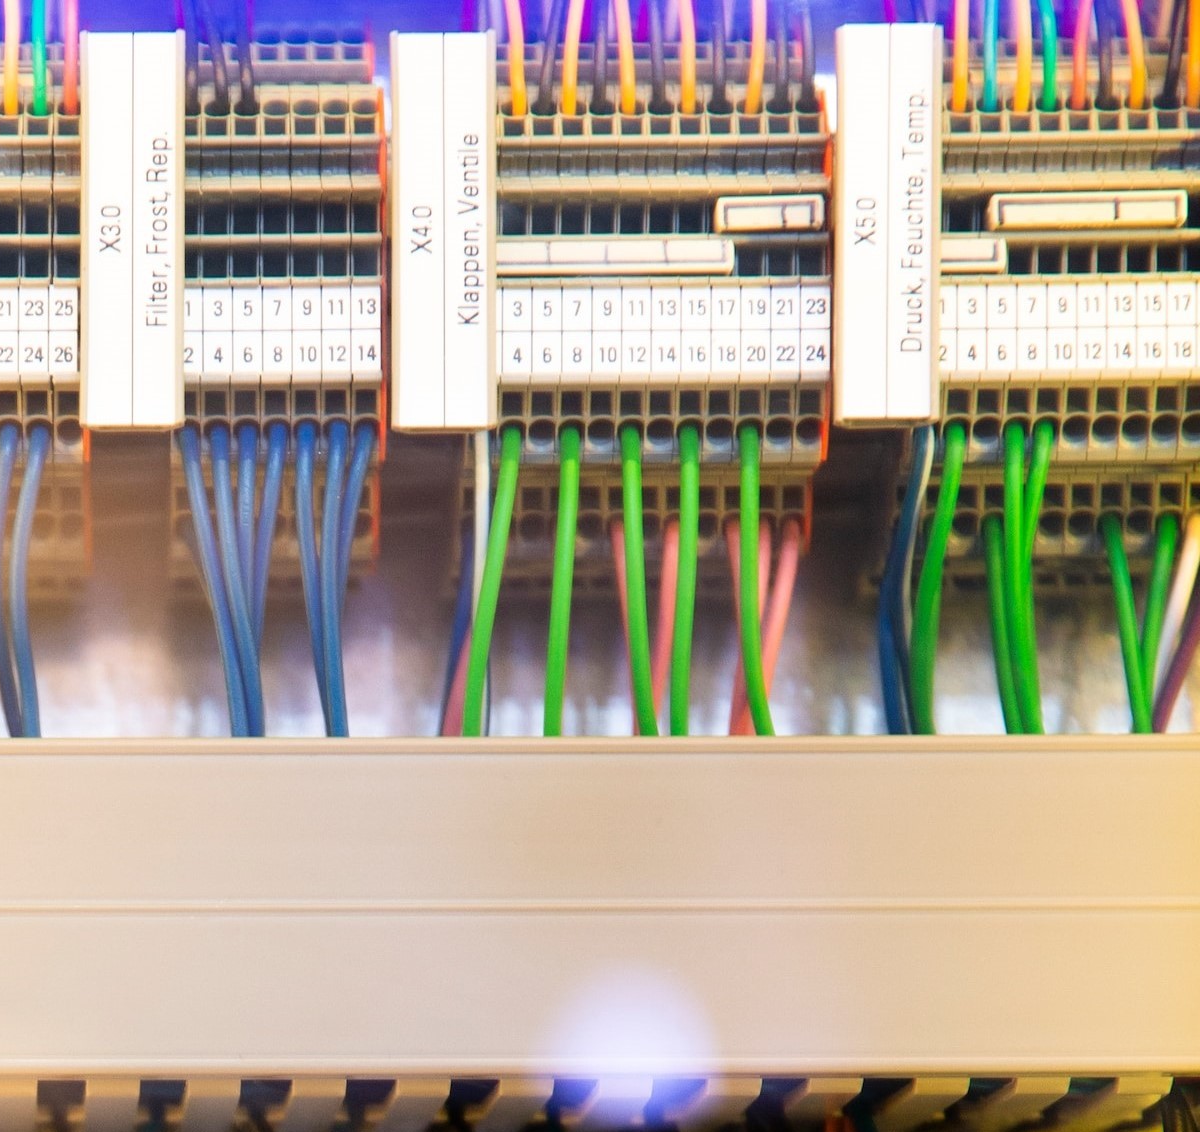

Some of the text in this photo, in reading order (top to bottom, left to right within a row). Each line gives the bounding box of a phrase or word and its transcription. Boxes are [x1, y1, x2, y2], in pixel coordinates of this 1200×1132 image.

[99, 206, 121, 253] X3.0
[145, 131, 173, 327] Filter, Frost, Rep.
[410, 206, 433, 254] X4.0
[457, 134, 485, 326] Klappen, Ventile
[854, 198, 877, 246] X5.0
[900, 88, 929, 352] Druck, Feuchte, Temp.
[24, 300, 44, 317] 23
[54, 299, 74, 316] 25
[185, 298, 377, 317] 1 3 5 7 9 11 13
[513, 298, 827, 318] 3 5 7 9 11 13 15 17 19 21 23
[967, 297, 977, 315] 3
[998, 297, 1008, 314] 5
[1028, 296, 1037, 314] 7
[1058, 297, 1068, 313] 9
[1084, 295, 1101, 313] 11
[1114, 295, 1133, 313] 13
[1144, 295, 1162, 312] 15
[1173, 293, 1192, 311] 17
[24, 346, 44, 363] 24
[54, 346, 74, 363] 26
[183, 344, 377, 364] 2 4 6 8 10 12 14
[512, 344, 827, 364] 4 6 8 10 12 14 16 18 20 22 24
[967, 344, 977, 361] 4
[997, 344, 1007, 361] 6
[1027, 343, 1038, 361] 8
[1054, 343, 1073, 360] 10
[1084, 342, 1102, 360] 12
[1115, 342, 1132, 358] 14
[1144, 342, 1162, 359] 16
[1174, 341, 1193, 358] 18
